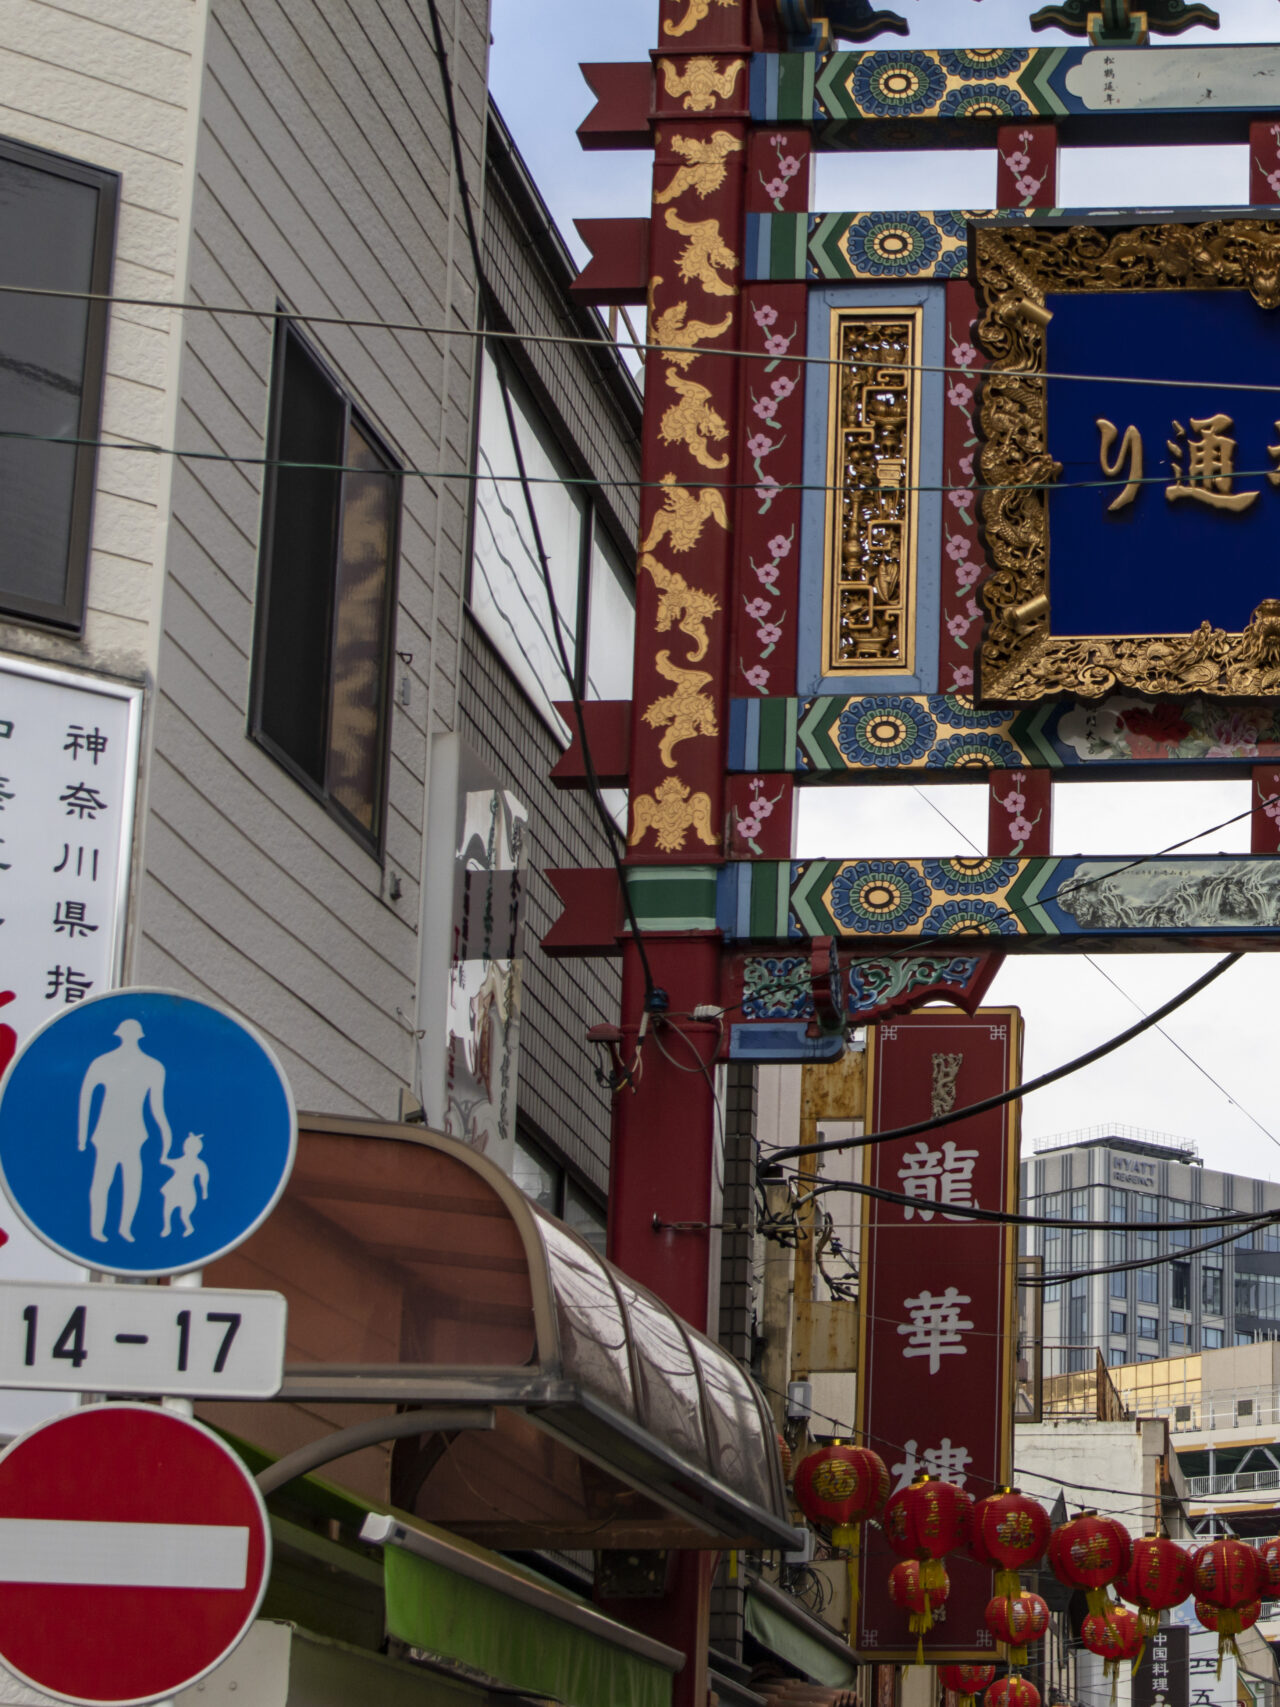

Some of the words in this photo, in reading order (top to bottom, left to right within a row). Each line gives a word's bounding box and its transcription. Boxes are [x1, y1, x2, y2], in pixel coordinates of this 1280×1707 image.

[1113, 1156, 1156, 1176] HYATT
[1113, 1171, 1155, 1188] REGENCY
[23, 1305, 242, 1373] 14-17
[1152, 1632, 1169, 1691] 中国料理
